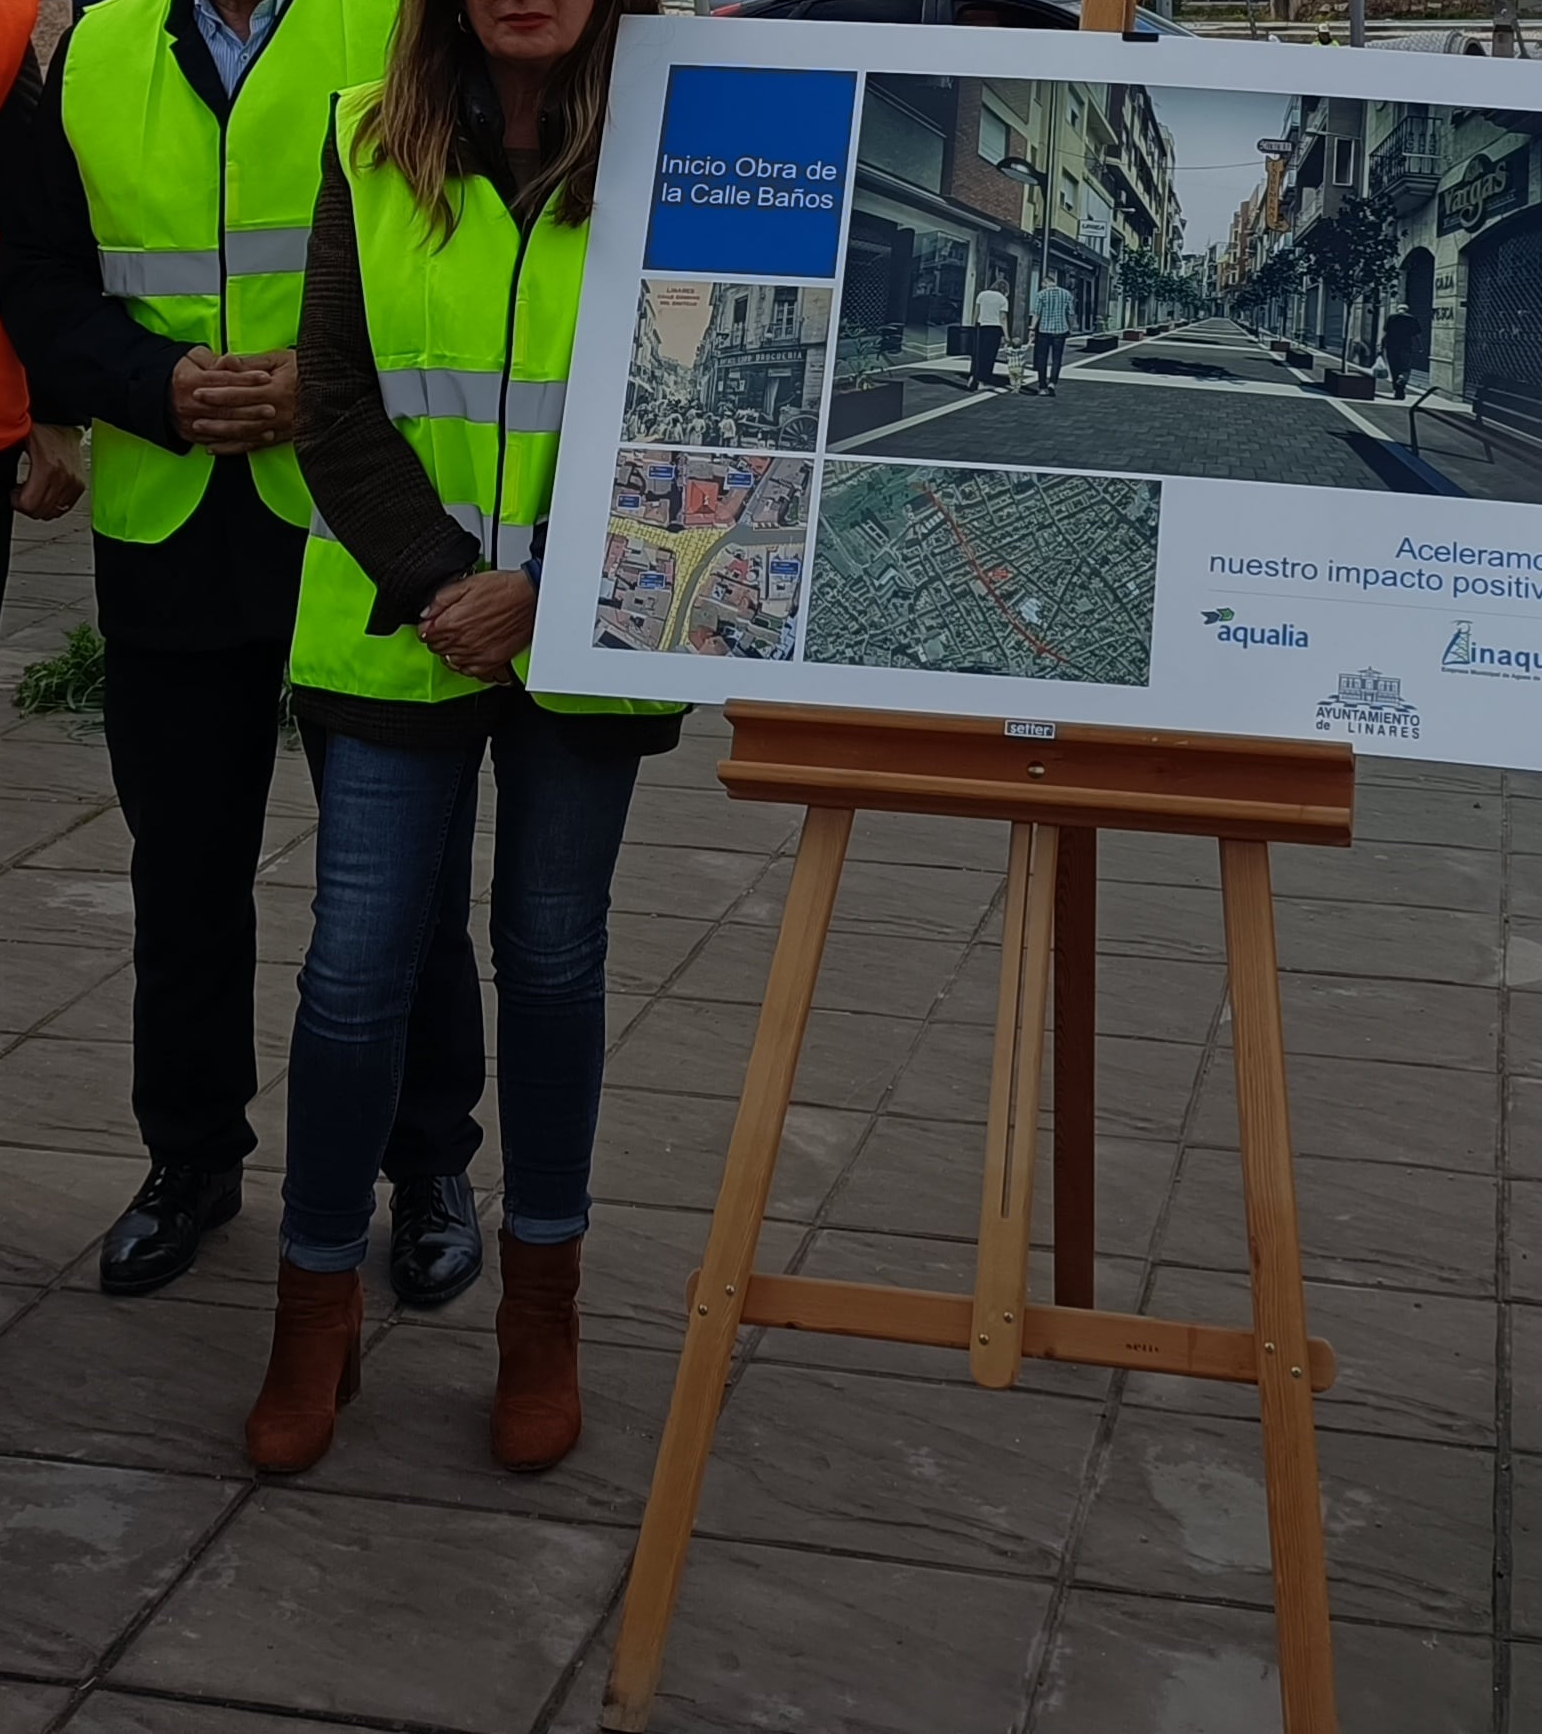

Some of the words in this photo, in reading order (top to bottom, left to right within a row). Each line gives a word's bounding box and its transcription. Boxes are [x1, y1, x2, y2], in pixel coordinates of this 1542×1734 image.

[662, 154, 727, 177] Inicio
[735, 157, 797, 179] Obra
[806, 160, 838, 181] de
[661, 182, 682, 203] la
[690, 183, 751, 205] Calle
[757, 186, 834, 210] Baños
[1209, 554, 1319, 581] nuestro
[1327, 560, 1443, 590] impacto
[1217, 623, 1309, 649] aqualia
[1315, 706, 1421, 727] AYUNTAMIENTO
[1315, 719, 1331, 731] de
[1347, 721, 1421, 740] LINARES
